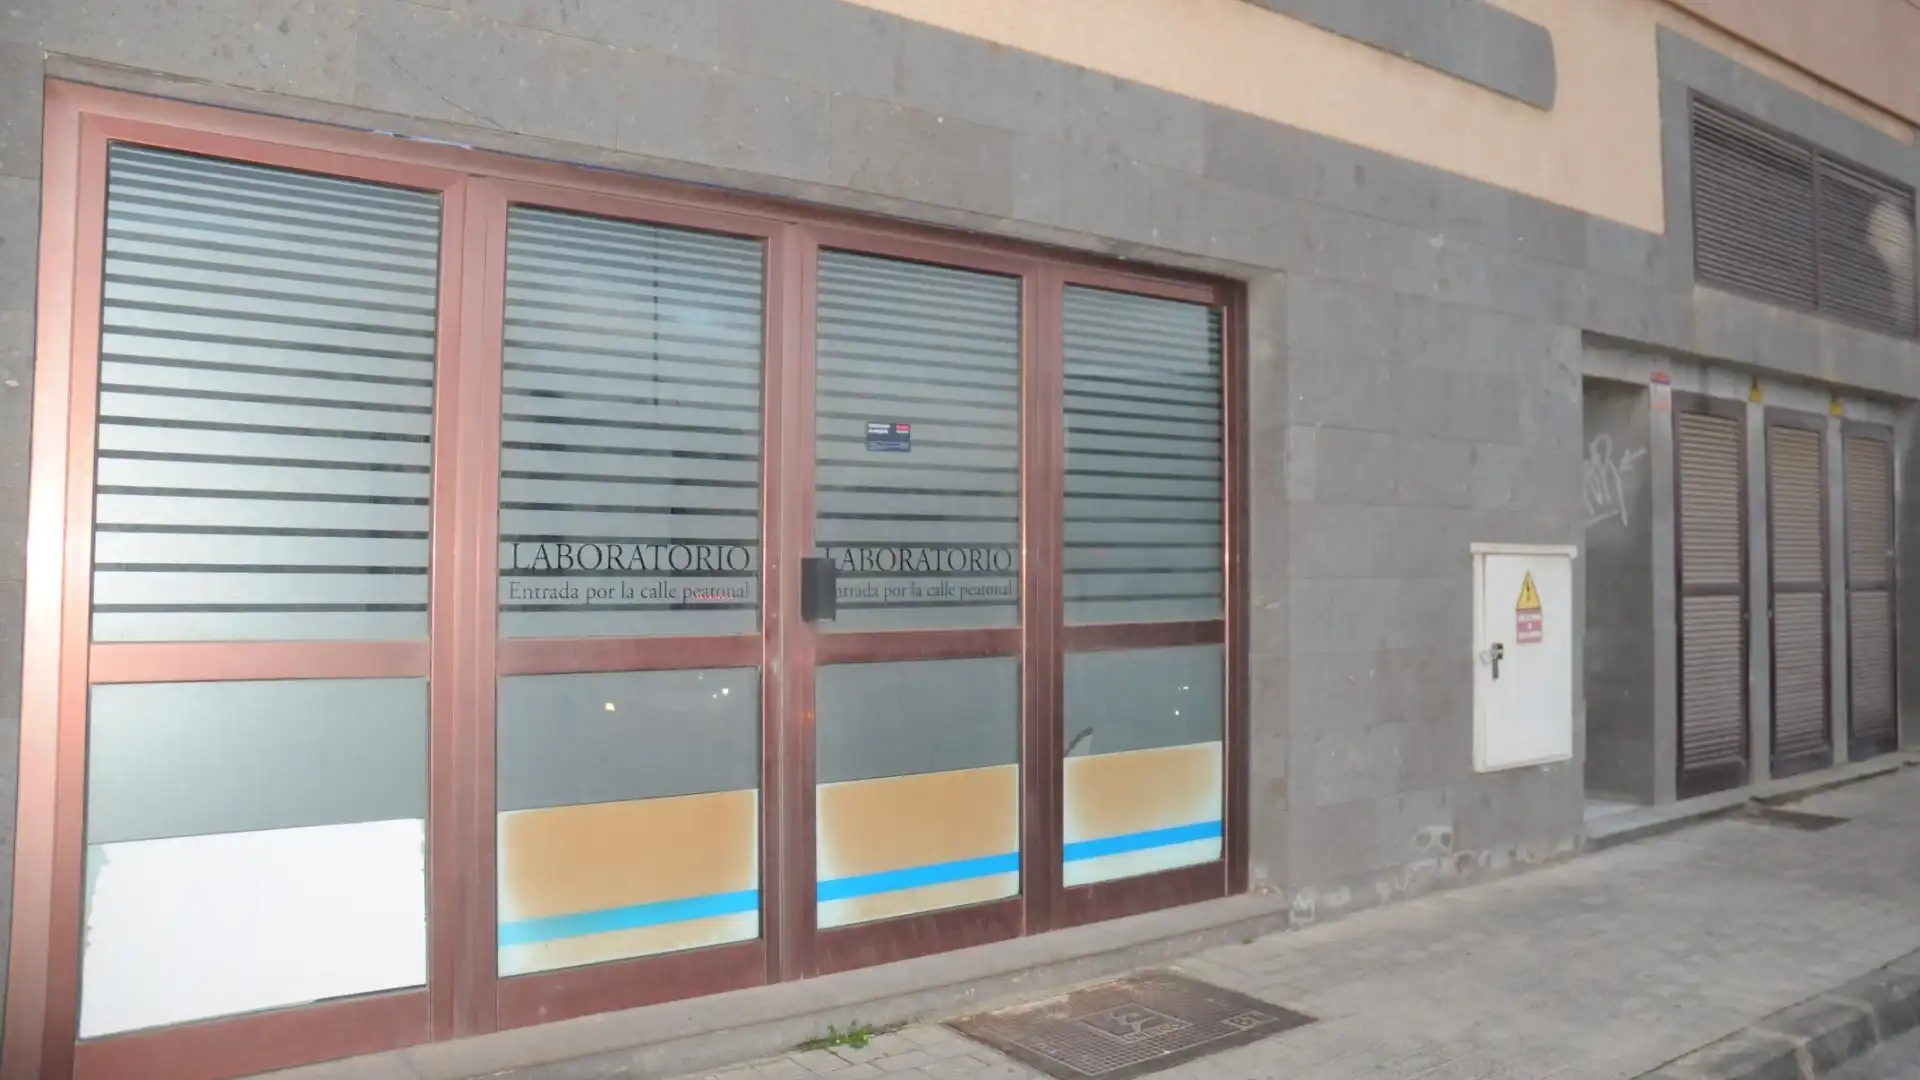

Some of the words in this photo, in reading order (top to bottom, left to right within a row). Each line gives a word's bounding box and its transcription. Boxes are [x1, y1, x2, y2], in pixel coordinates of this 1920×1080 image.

[511, 543, 750, 571] LABORATORIO
[508, 581, 579, 599] Entrada
[586, 586, 615, 604] por
[621, 580, 634, 599] la
[640, 580, 677, 599] calle
[682, 581, 750, 604] peatonal
[885, 586, 908, 604] por
[911, 581, 922, 597] la
[927, 580, 956, 597] calle
[960, 580, 1012, 601] peatonal
